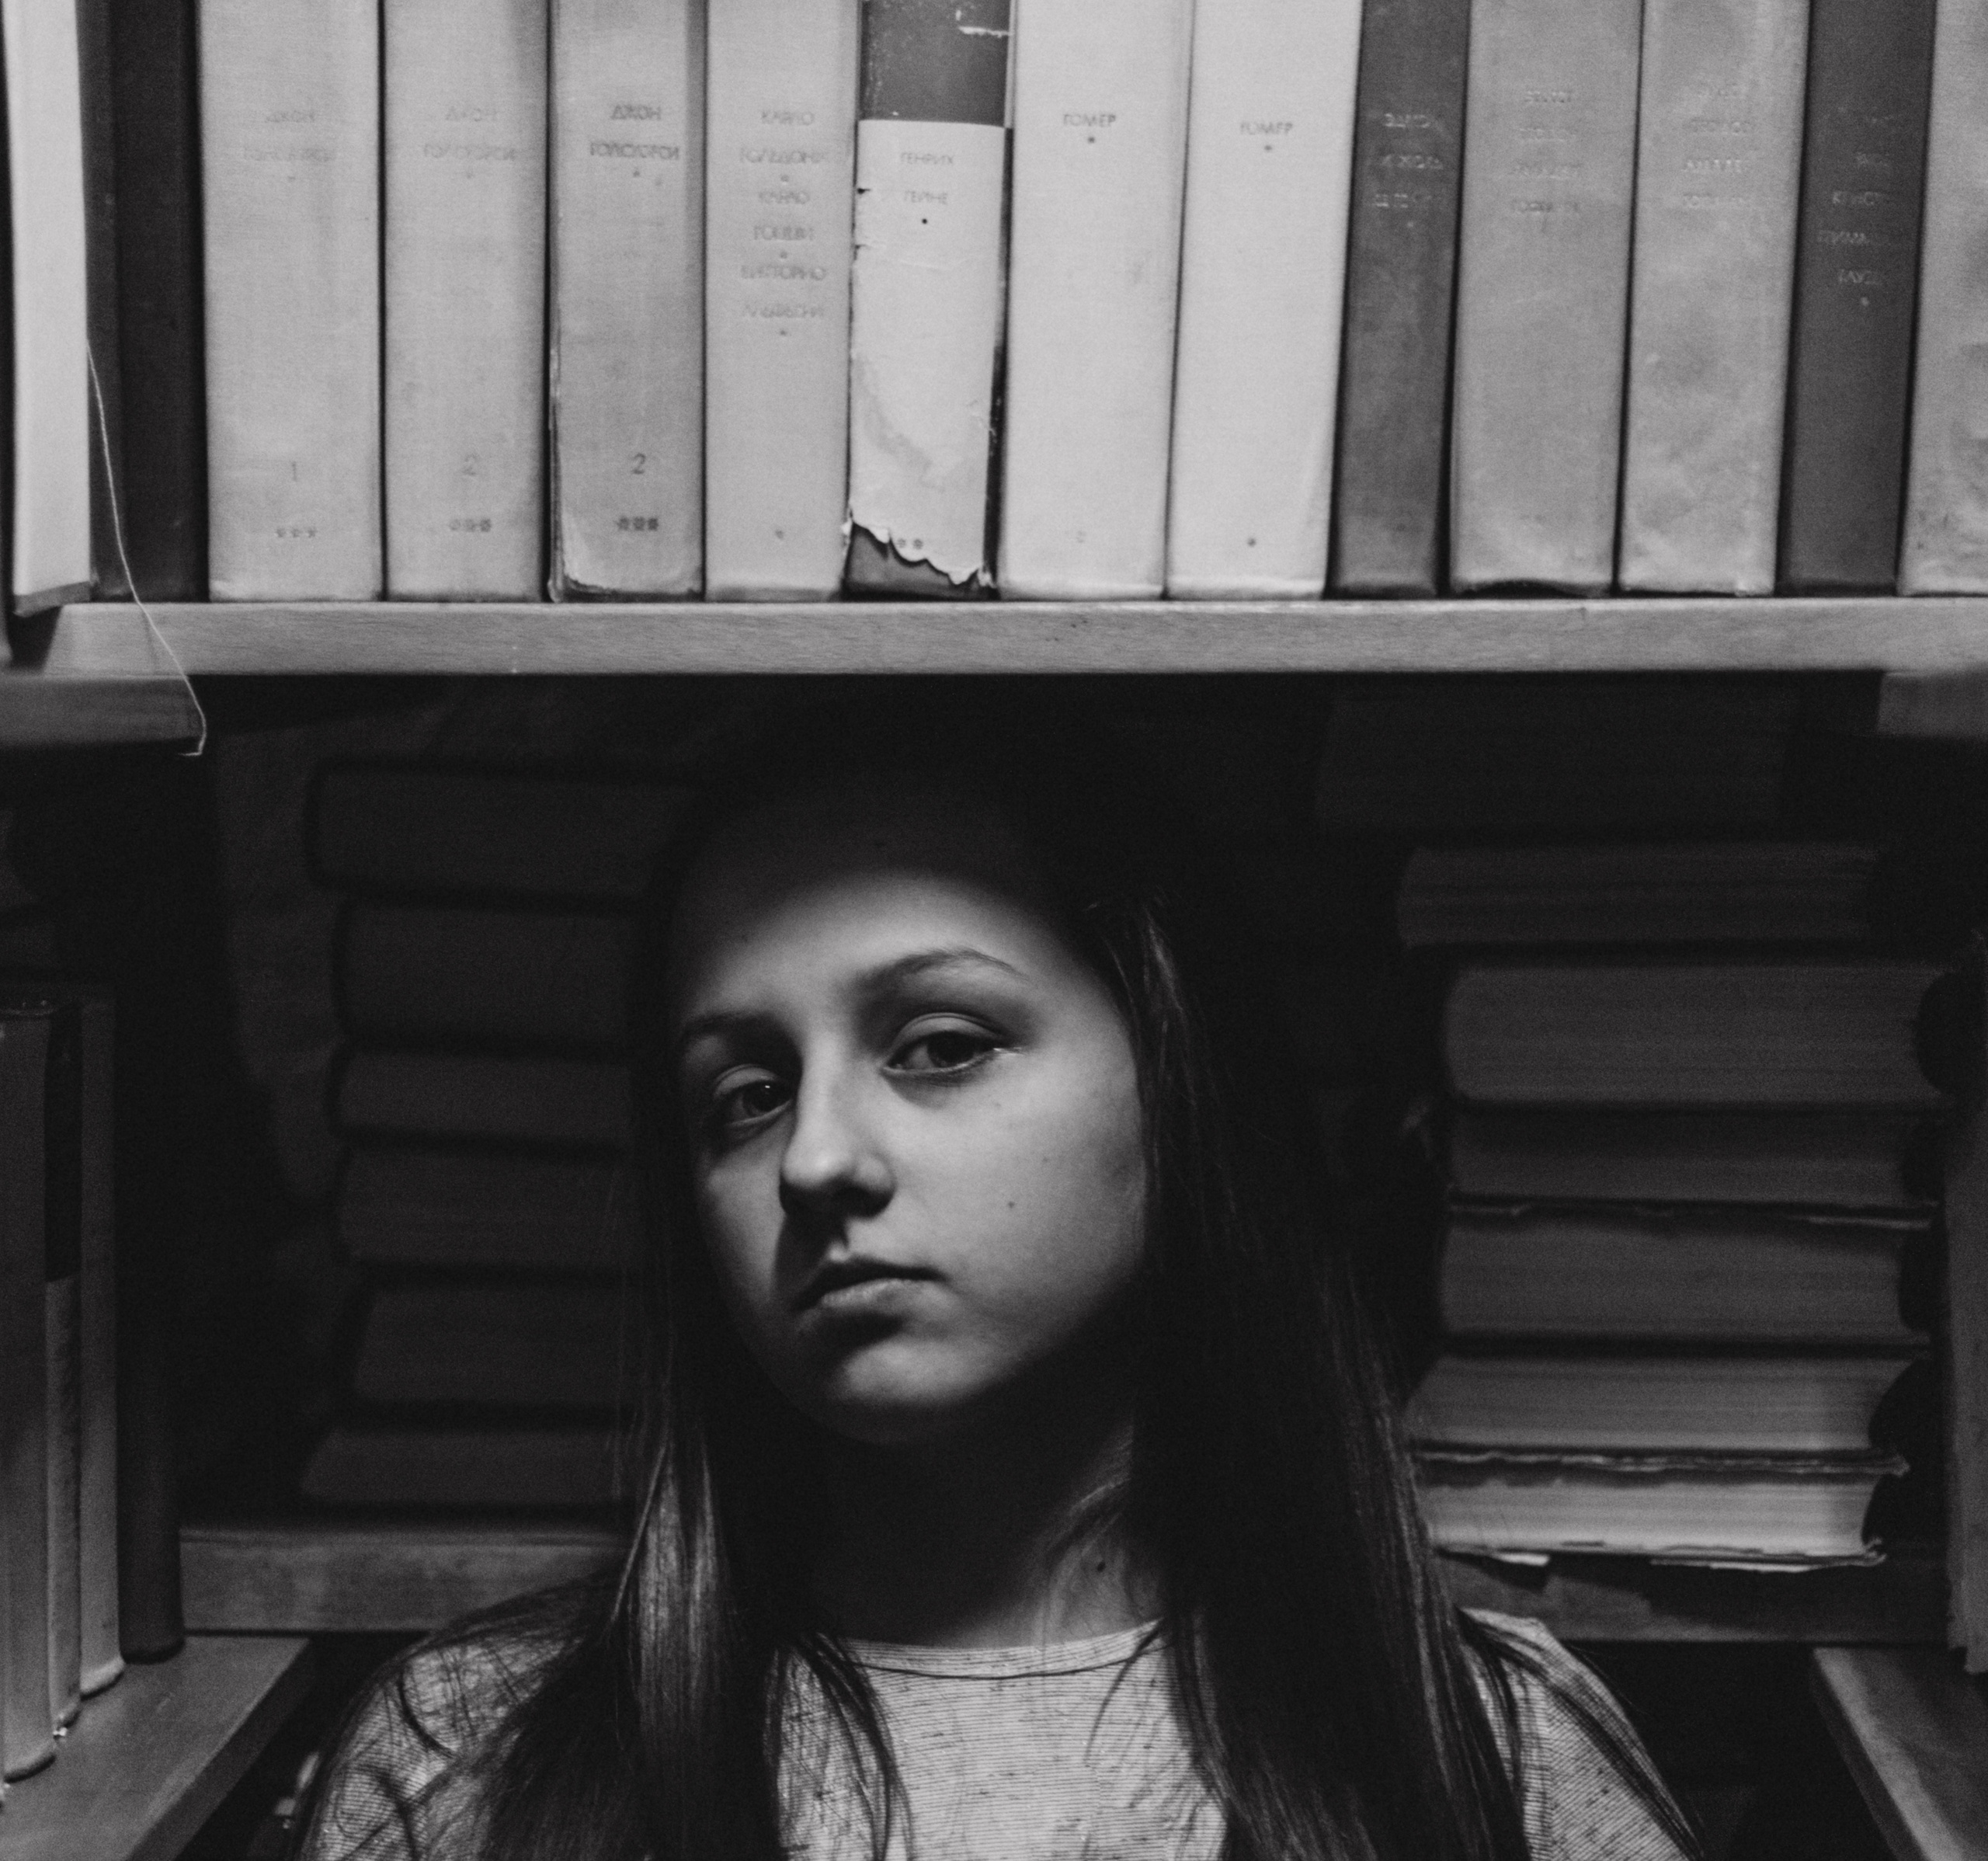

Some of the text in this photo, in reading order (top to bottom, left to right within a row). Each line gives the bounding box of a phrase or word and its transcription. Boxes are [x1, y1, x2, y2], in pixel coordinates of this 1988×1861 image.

[1062, 113, 1117, 127] ГОМЕР
[1240, 120, 1294, 135] ГОМЕР
[290, 461, 298, 482] 1
[630, 452, 647, 475] 2
